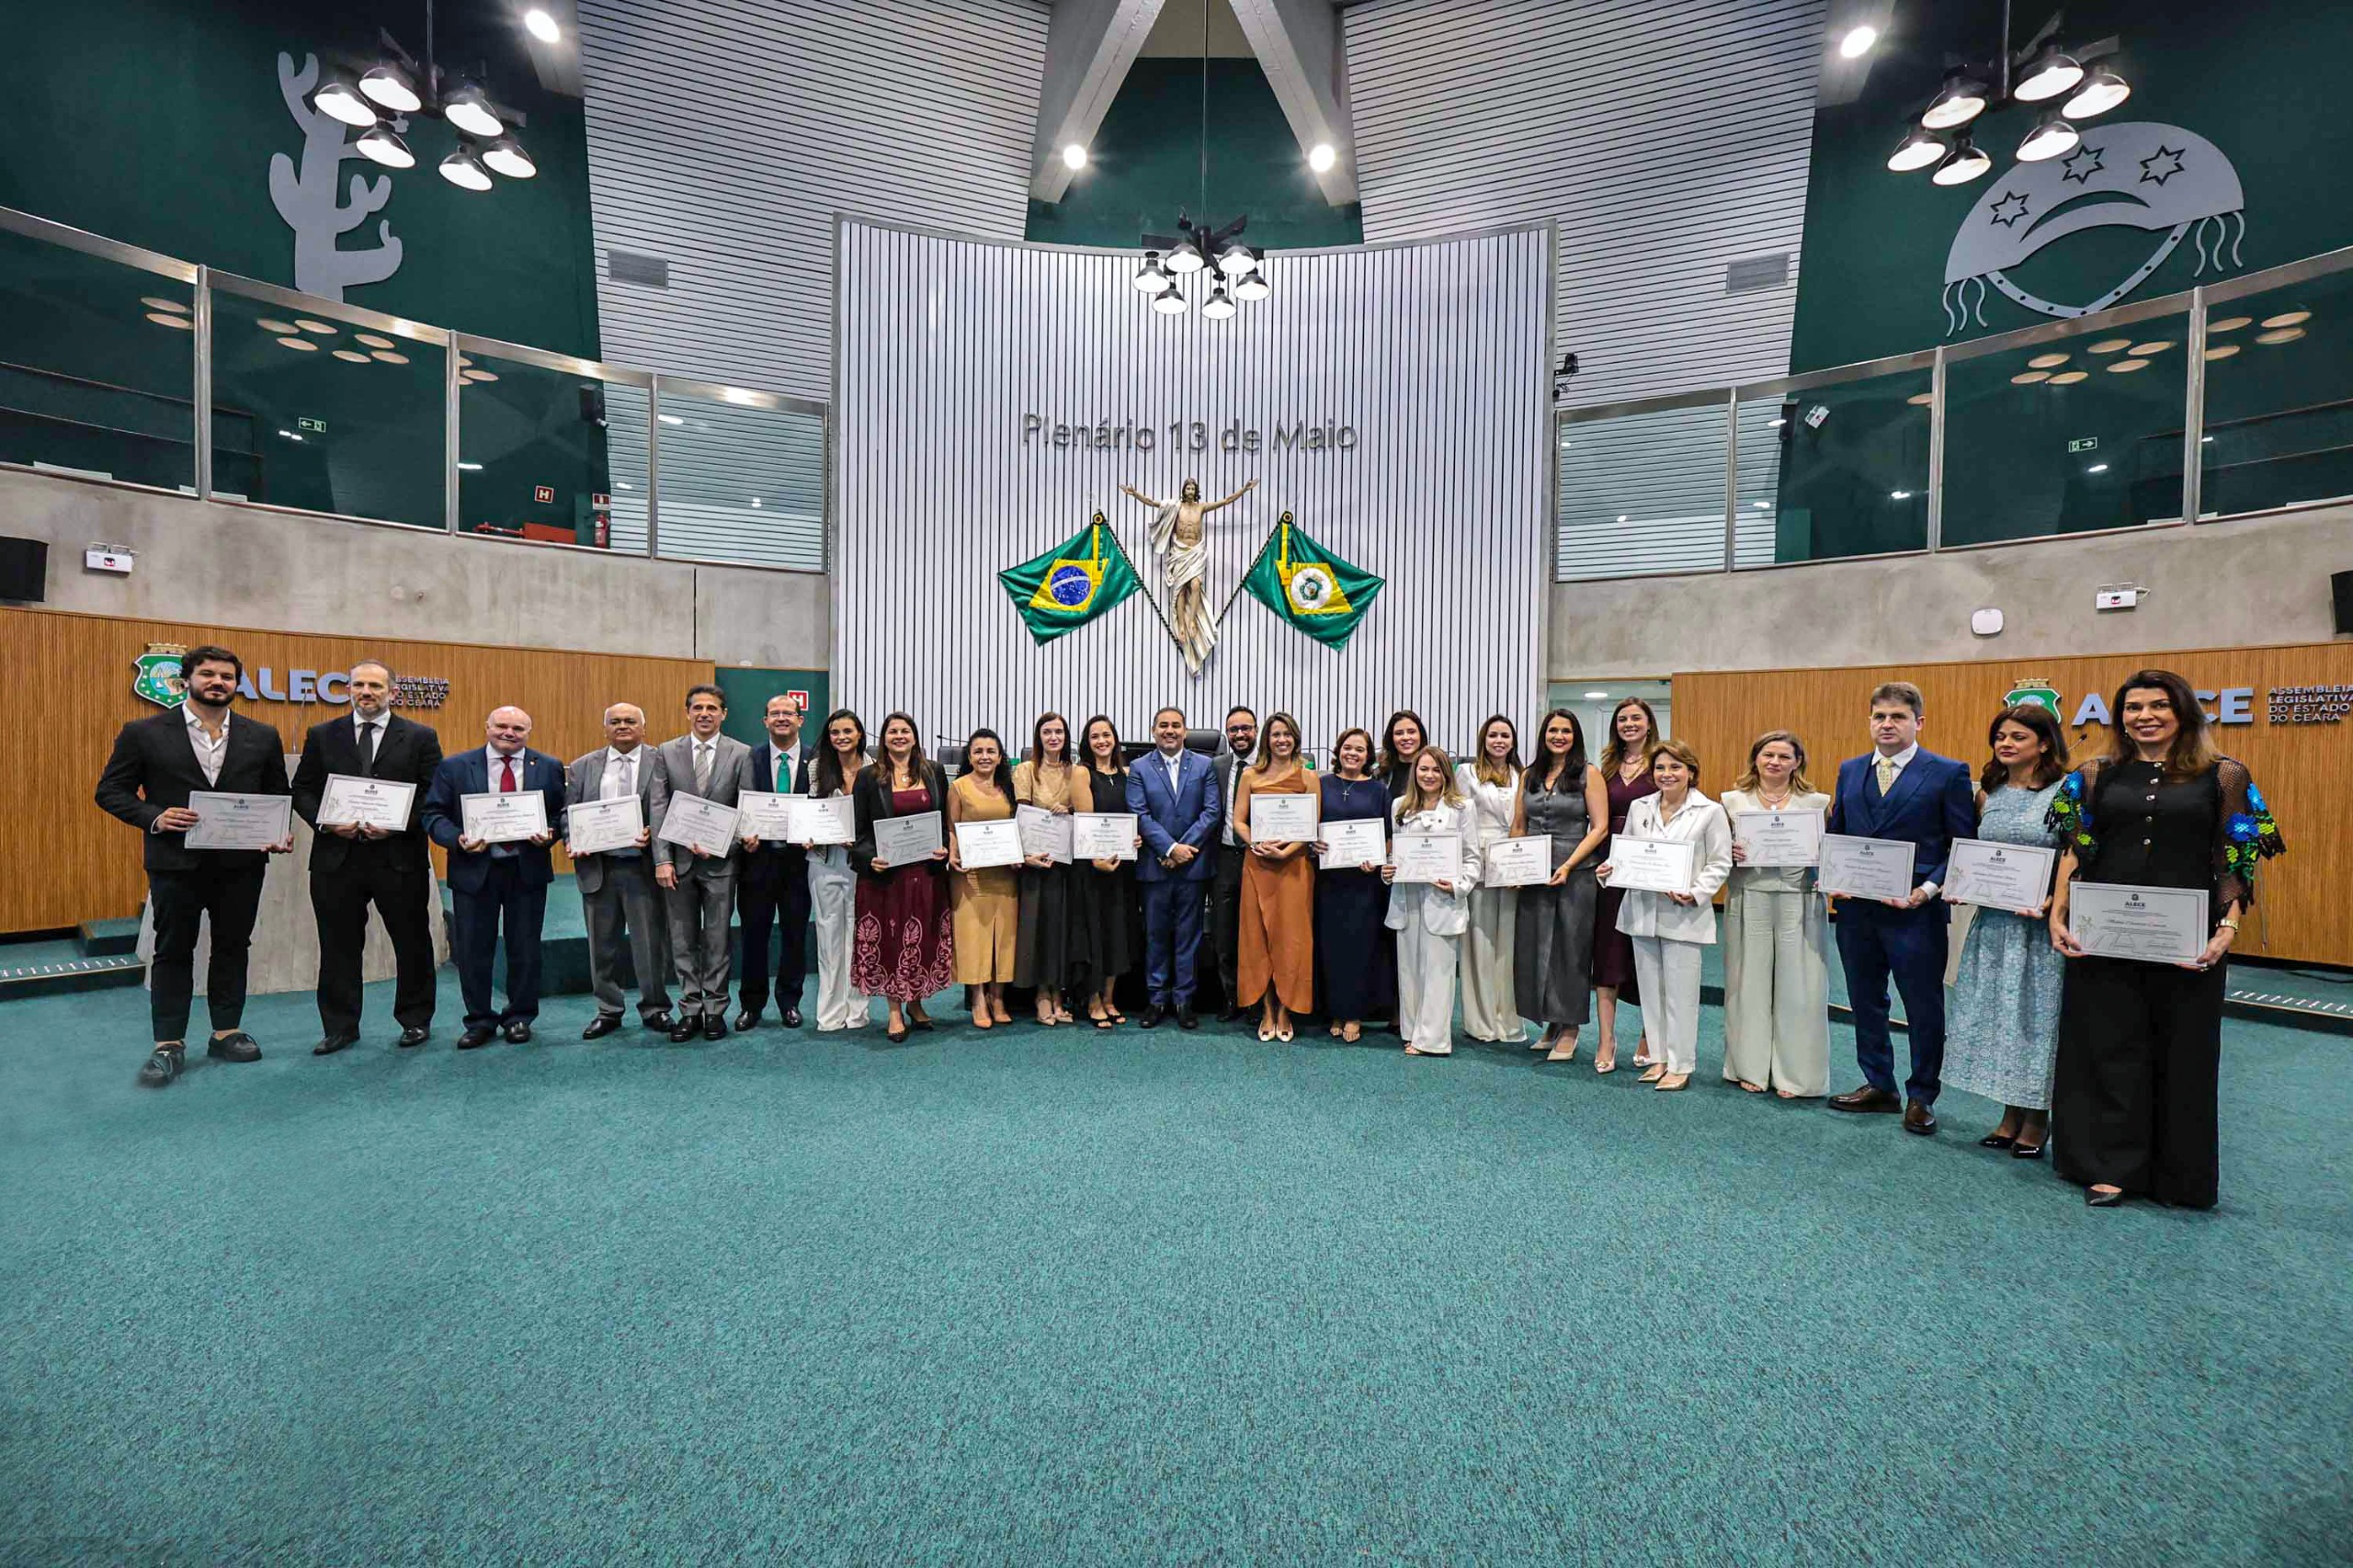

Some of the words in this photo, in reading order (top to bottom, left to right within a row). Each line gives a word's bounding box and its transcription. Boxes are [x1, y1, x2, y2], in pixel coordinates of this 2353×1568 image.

[1022, 413, 1155, 450] Plenário
[1169, 420, 1207, 450] 13
[1221, 417, 1261, 451] de
[1272, 417, 1358, 451] Maio
[539, 489, 551, 500] H
[235, 667, 351, 704] ALEC
[396, 676, 449, 685] SSEMBLEIA
[2269, 684, 2353, 695] ASSEMBLEIA
[2269, 705, 2289, 713] DO
[2293, 702, 2350, 713] ESTADO
[2269, 714, 2288, 722] DO
